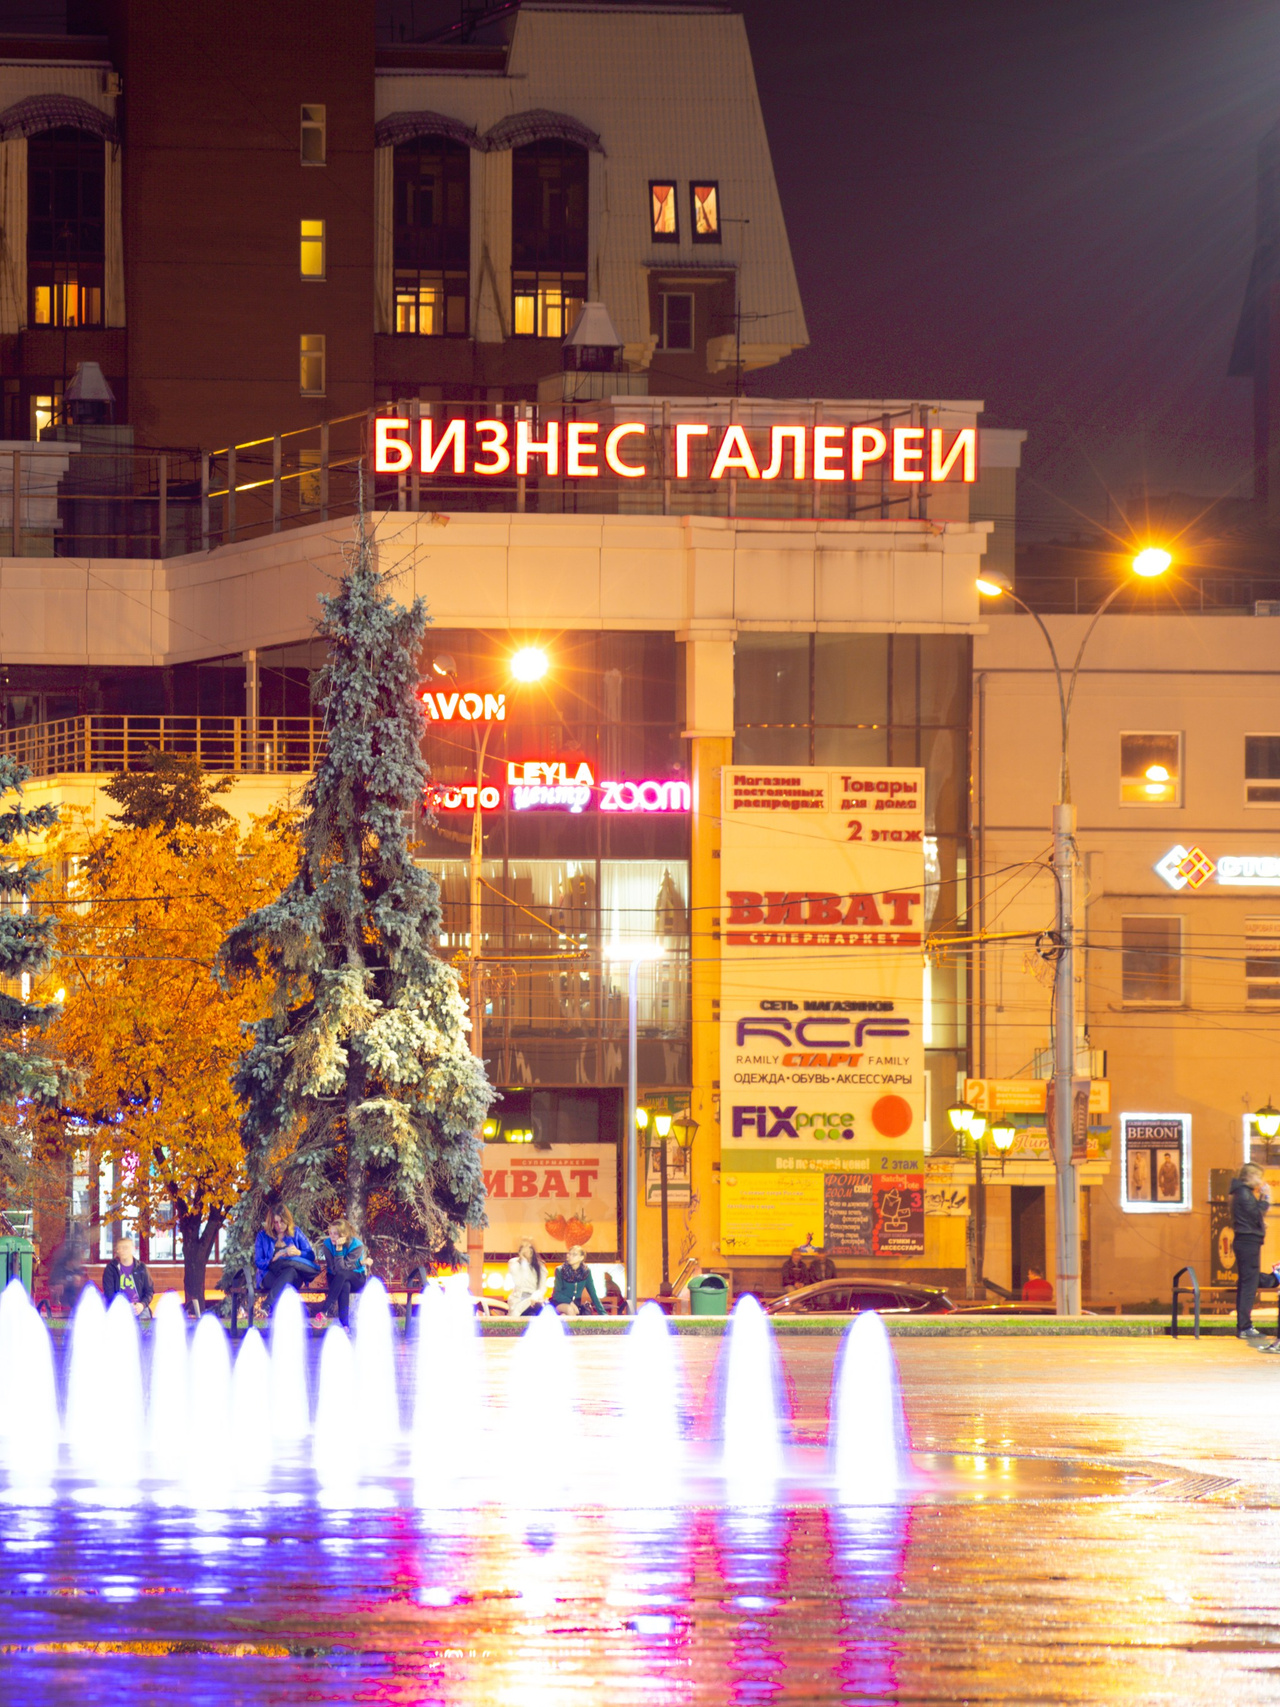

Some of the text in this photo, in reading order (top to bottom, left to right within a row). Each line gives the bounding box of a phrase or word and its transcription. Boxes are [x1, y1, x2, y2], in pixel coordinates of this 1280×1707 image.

[373, 416, 977, 482] БИЗНЕС ГАЛЕРЕИ
[421, 693, 505, 720] AVON
[507, 762, 594, 785] LEYLA
[733, 775, 801, 786] Магазин
[841, 776, 918, 797] Товары
[733, 788, 824, 798] постоянных
[733, 798, 824, 810] распродаж
[841, 798, 917, 811] для дома
[847, 820, 923, 842] 2 этаж
[726, 891, 921, 926] ВИВАТ
[750, 933, 901, 944] СУПЕРМАРКЕТ
[760, 1000, 895, 1012] СЕТЬ МАГАЗИНОВ
[736, 1055, 780, 1065] RAMILY
[782, 1052, 864, 1067] СТАРТ
[868, 1056, 910, 1066] FAMILY
[836, 1074, 913, 1085] АКСЕССУАРЫ
[1128, 1127, 1179, 1139] BERONI
[776, 1157, 794, 1170] Всё
[881, 1157, 919, 1170] 2 этаж
[483, 1169, 598, 1199] ИВАТ
[910, 1192, 922, 1208] 3
